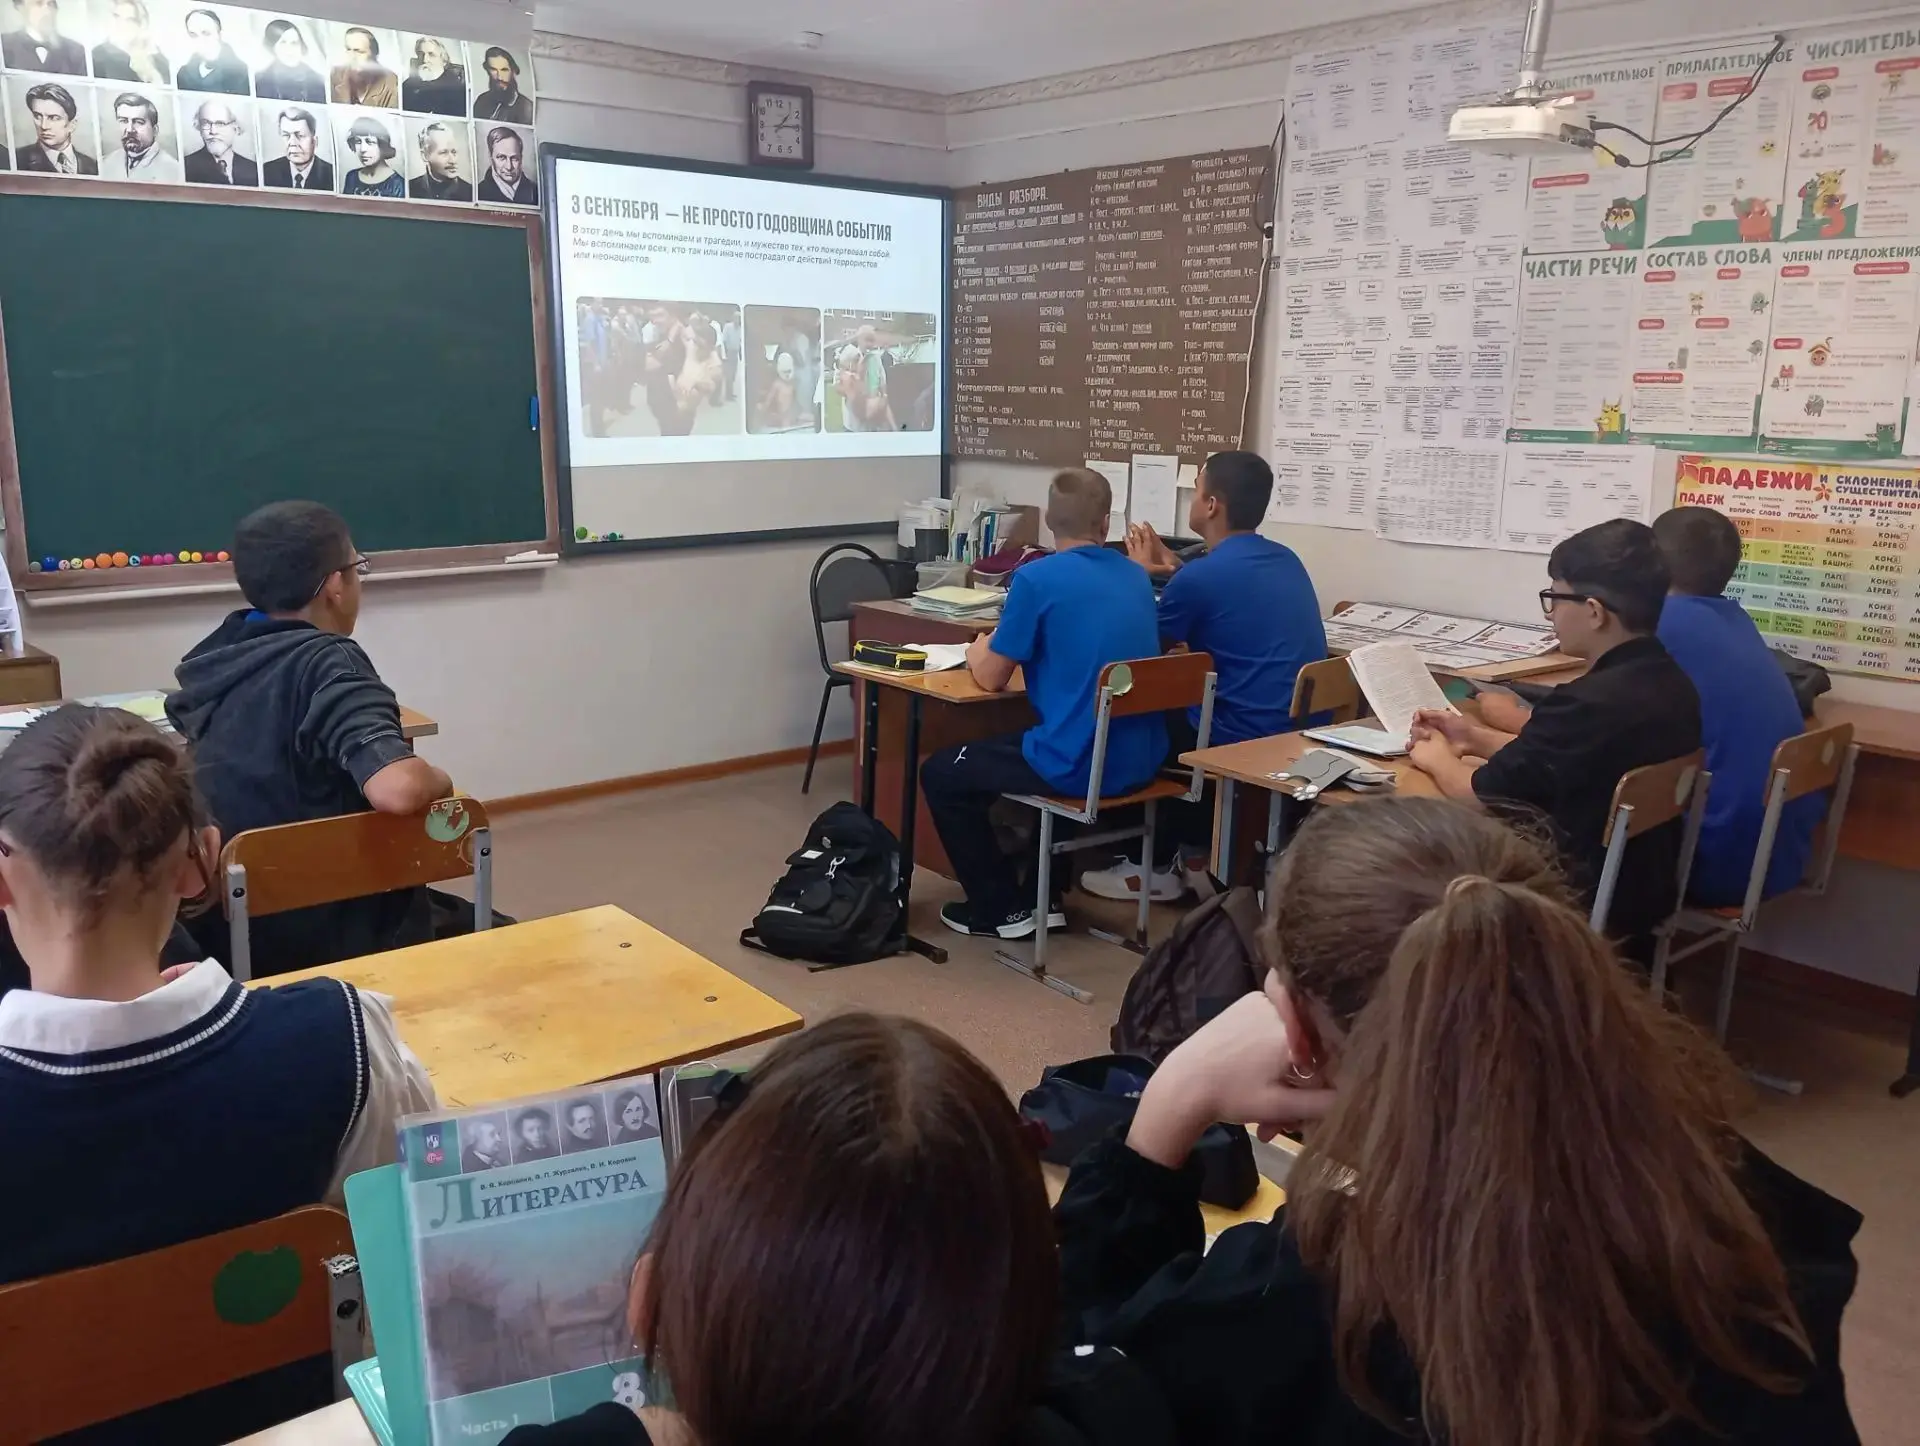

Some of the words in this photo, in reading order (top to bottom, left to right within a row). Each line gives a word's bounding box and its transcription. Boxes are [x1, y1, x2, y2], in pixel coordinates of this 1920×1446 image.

[1806, 30, 1920, 60] ЧИСЛИТЕЛЬ
[977, 192, 1002, 208] ВИДЫ
[1009, 186, 1048, 204] РАЗБОРА.
[571, 194, 580, 214] 3
[584, 196, 659, 221] СЕНТЯБРЯ
[682, 205, 700, 225] НЕ
[703, 207, 754, 230] ПРОСТО
[757, 212, 834, 236] ГОДОВЩИНА
[836, 220, 892, 242] СОБЫТИЯ
[572, 225, 579, 233] В
[602, 228, 624, 238] день
[626, 230, 640, 238] мы
[642, 231, 695, 243] вспоминаем
[703, 236, 742, 248] трагедии,
[572, 237, 588, 246] Мы
[590, 240, 646, 251] вспоминаем
[671, 246, 686, 254] кто
[688, 247, 701, 255] так
[720, 249, 743, 258] иначе
[745, 251, 786, 262] пострадал
[787, 254, 796, 262] от
[797, 255, 832, 265] действий
[573, 251, 590, 259] или
[592, 252, 651, 264] неонацистов.
[1647, 251, 1708, 268] СОСТАВ
[1715, 248, 1771, 265] СЛОВА
[1782, 249, 1823, 263] ЧЛЕНЫ
[1827, 246, 1920, 261] ПРЕДЛОЖЕНИЯ
[1525, 259, 1582, 279] ЧАСТИ
[1589, 256, 1637, 276] РЕЧИ
[1699, 466, 1813, 491] ПАДЕЖИ
[1820, 474, 1828, 484] И
[1836, 475, 1912, 489] СКЛОНЕНИЯ
[1680, 492, 1724, 505] ПАДЕЖ
[1838, 498, 1892, 508] ПАДЕЖНЫЕ
[1869, 509, 1876, 517] 2
[429, 1169, 648, 1229] ЛИТЕРАТУРА
[612, 1371, 645, 1409] 8
[461, 1419, 507, 1436] Часть
